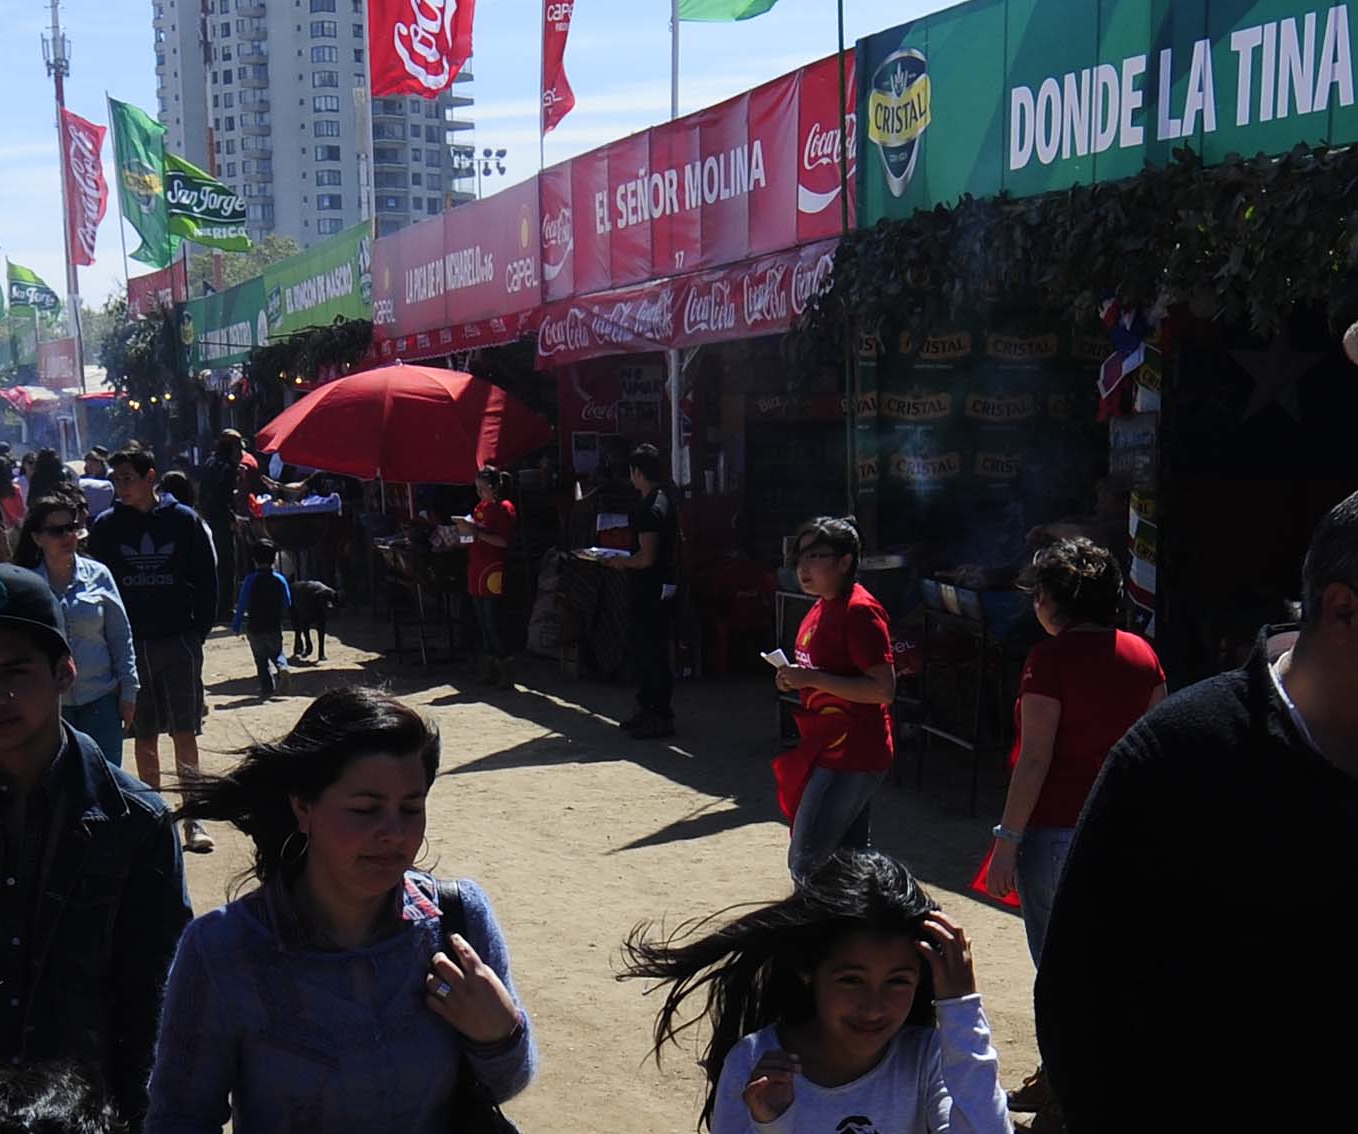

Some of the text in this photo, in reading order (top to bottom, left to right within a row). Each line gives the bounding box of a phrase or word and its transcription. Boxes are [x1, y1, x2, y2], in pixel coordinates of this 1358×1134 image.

[874, 94, 927, 135] CRISTAL
[1009, 5, 1355, 171] DONDE LA TINA
[594, 139, 766, 235] EL SEÑOR MOLINA
[123, 573, 174, 585] adidas
